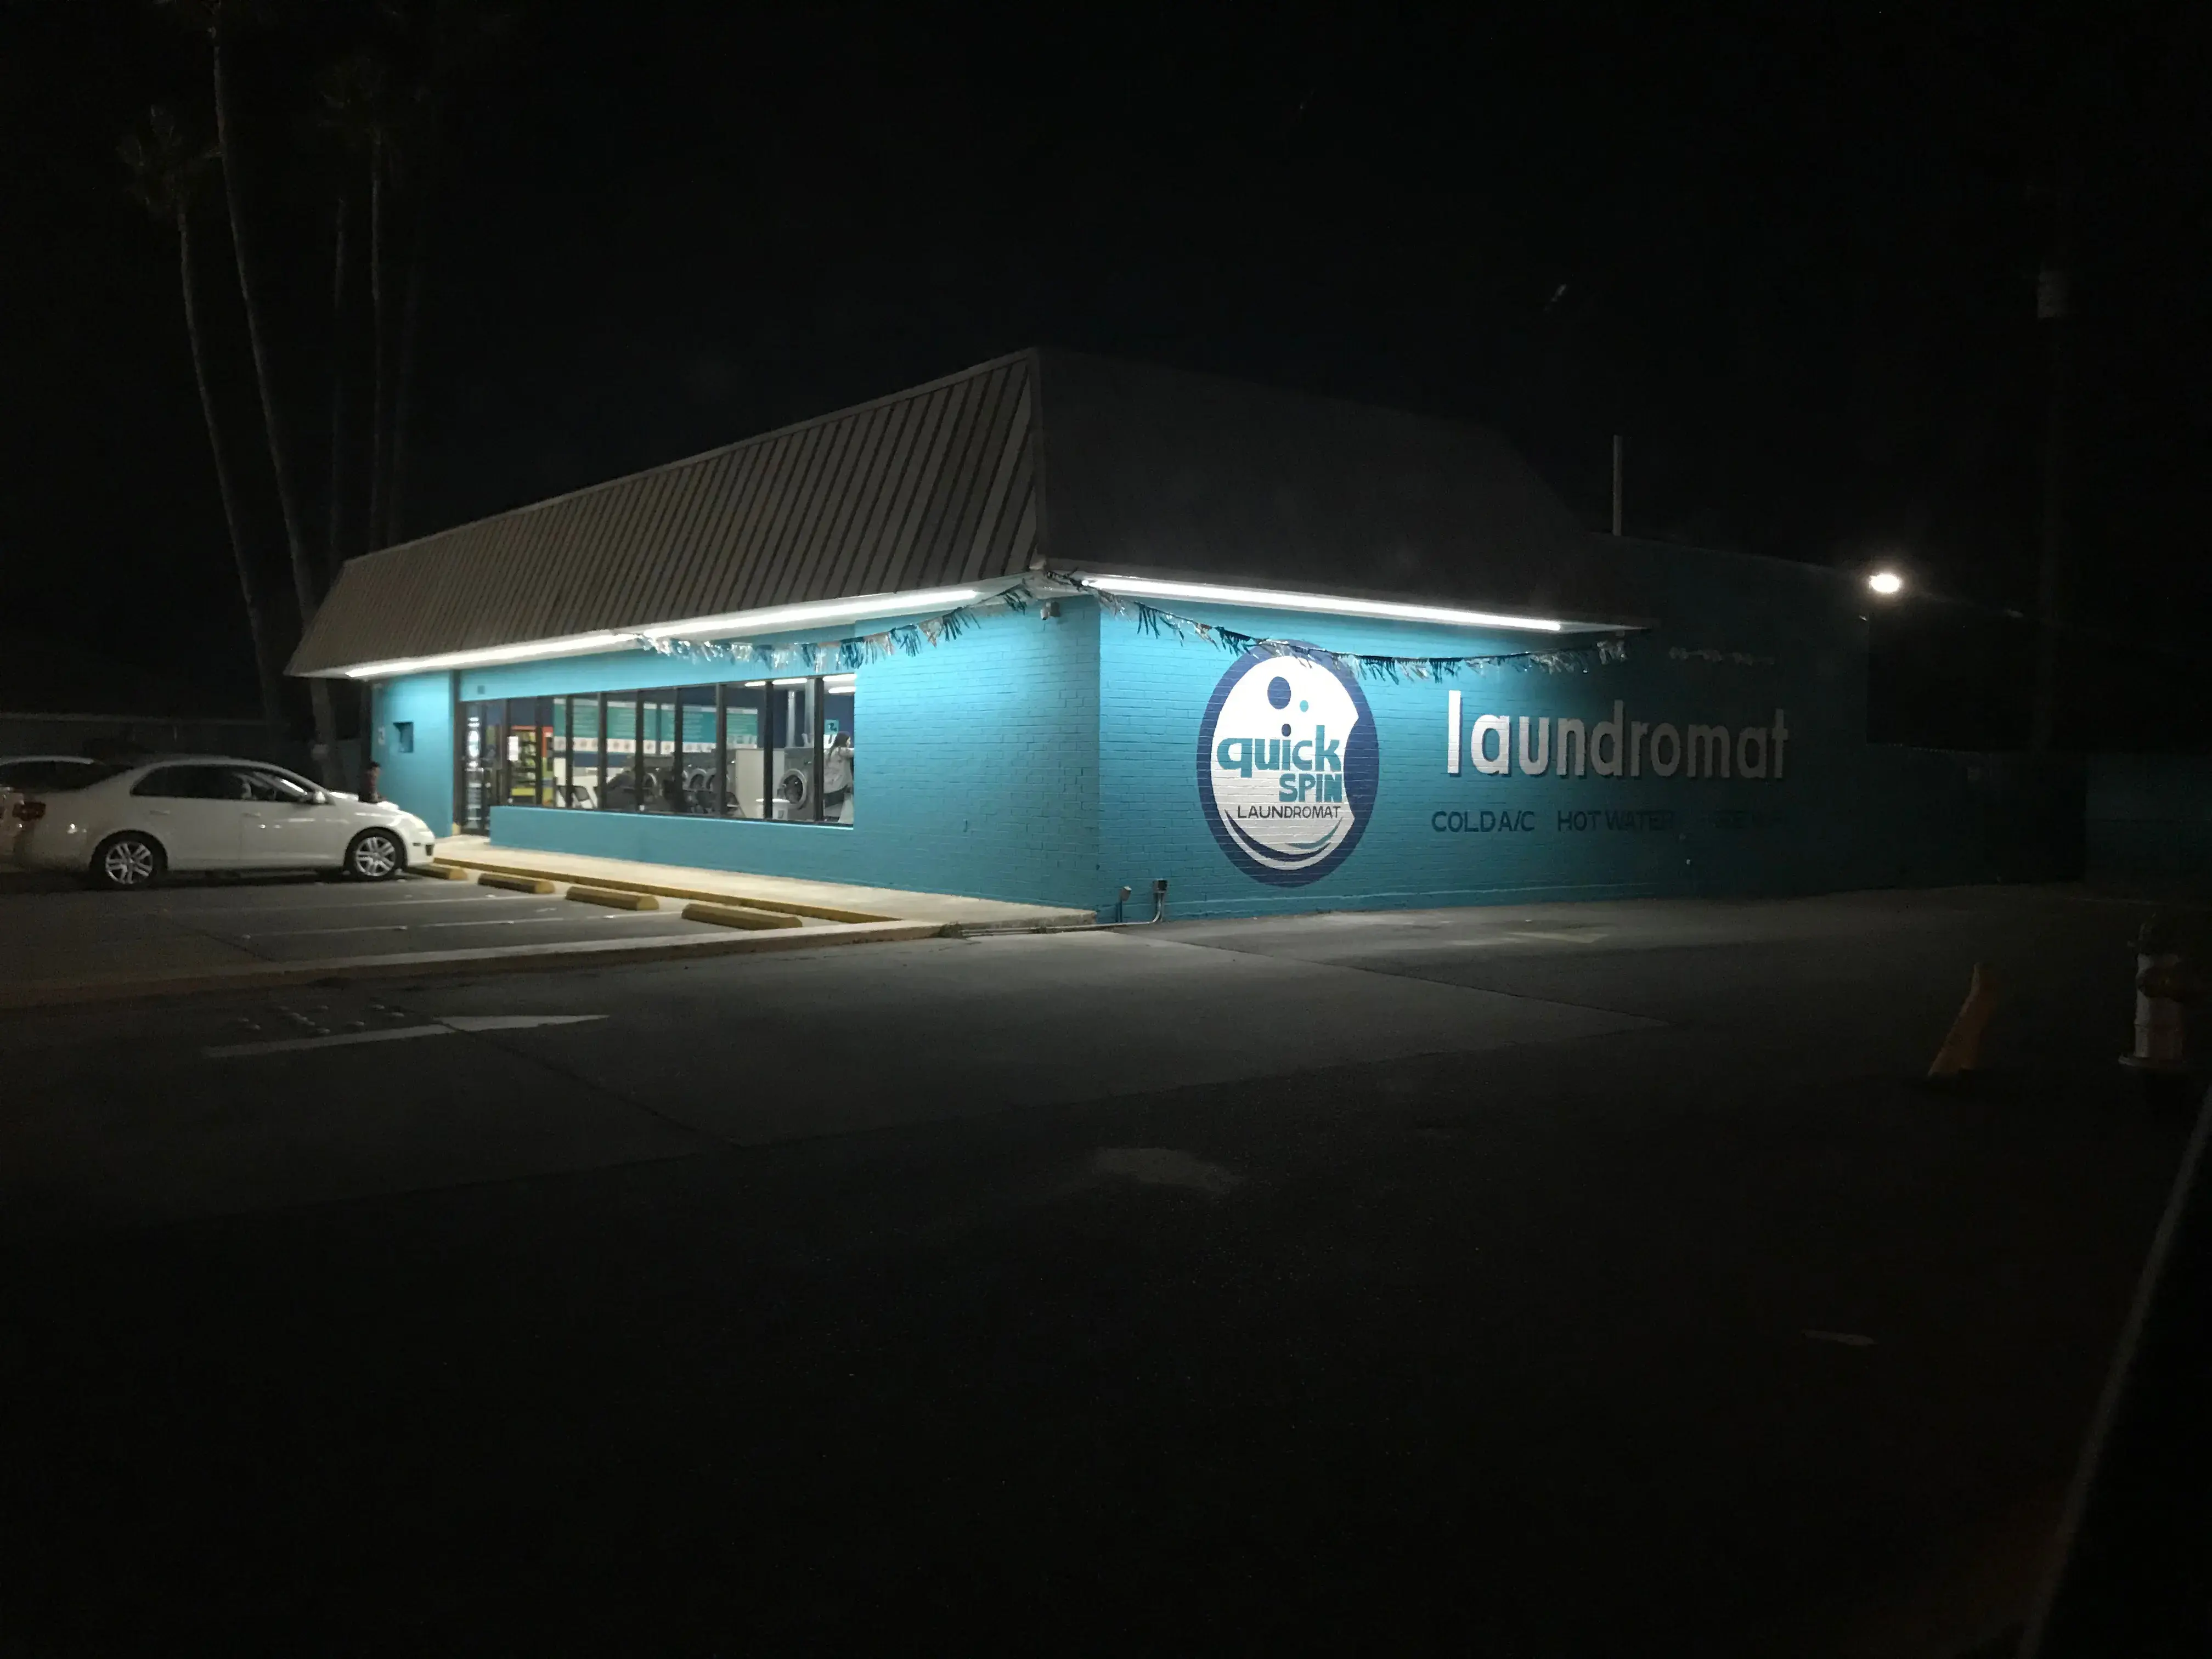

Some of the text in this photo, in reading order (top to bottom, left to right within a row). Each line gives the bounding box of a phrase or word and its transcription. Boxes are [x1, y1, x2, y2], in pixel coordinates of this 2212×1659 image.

[1217, 724, 1342, 778] quick
[1447, 690, 1789, 780] laundromat
[1279, 773, 1343, 803] SPIN
[1238, 805, 1341, 819] LAUNDROMAT
